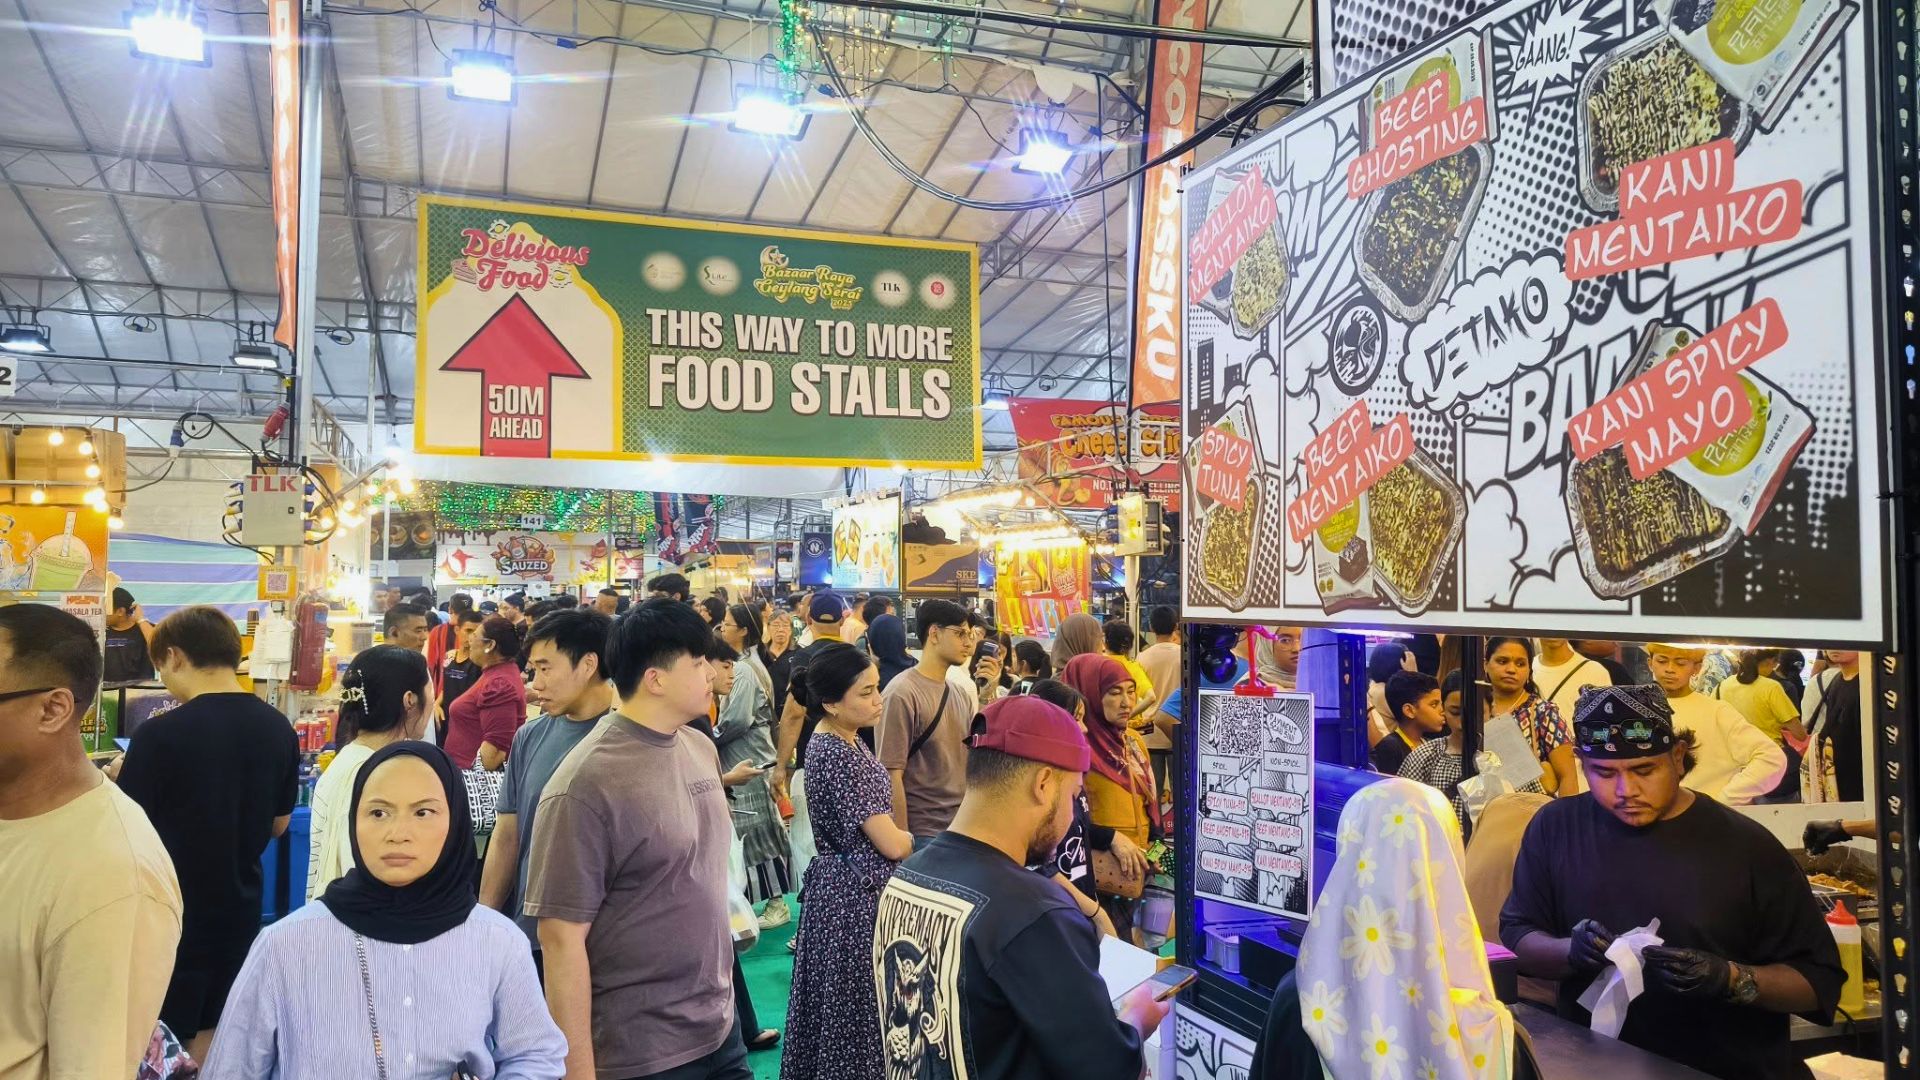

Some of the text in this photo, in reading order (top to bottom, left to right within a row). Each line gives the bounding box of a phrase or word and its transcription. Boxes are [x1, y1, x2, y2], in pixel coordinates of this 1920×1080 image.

[1380, 78, 1443, 139] BEEF
[1351, 105, 1477, 193] GHOSTING
[1626, 148, 1723, 209] KANI
[1193, 172, 1256, 262] SCALLOP
[1573, 188, 1787, 273] MENTAIKO
[463, 229, 590, 266] Delicious
[1191, 195, 1270, 293] MENTAIKO
[478, 259, 549, 290] Food
[759, 280, 861, 300] Geylang Serai
[764, 265, 855, 286] Bazaar Raya
[881, 282, 901, 292] TLK
[647, 310, 953, 361] THIS WAY TO MORE
[648, 356, 951, 418] FOOD STALLS
[1573, 382, 1654, 454] KANI
[1665, 307, 1767, 400] SPICY
[488, 385, 544, 416] 50M
[489, 416, 542, 440] AHEAD
[1308, 408, 1365, 477] BEEF
[1631, 385, 1735, 472] MAYO
[1204, 429, 1249, 468] SPICY
[246, 475, 297, 492] TLK
[1202, 464, 1241, 503] TUNA
[1291, 423, 1403, 531] MENTAIKO
[523, 517, 541, 526] 141
[501, 556, 549, 575] SAUZED
[956, 570, 976, 579] SKP
